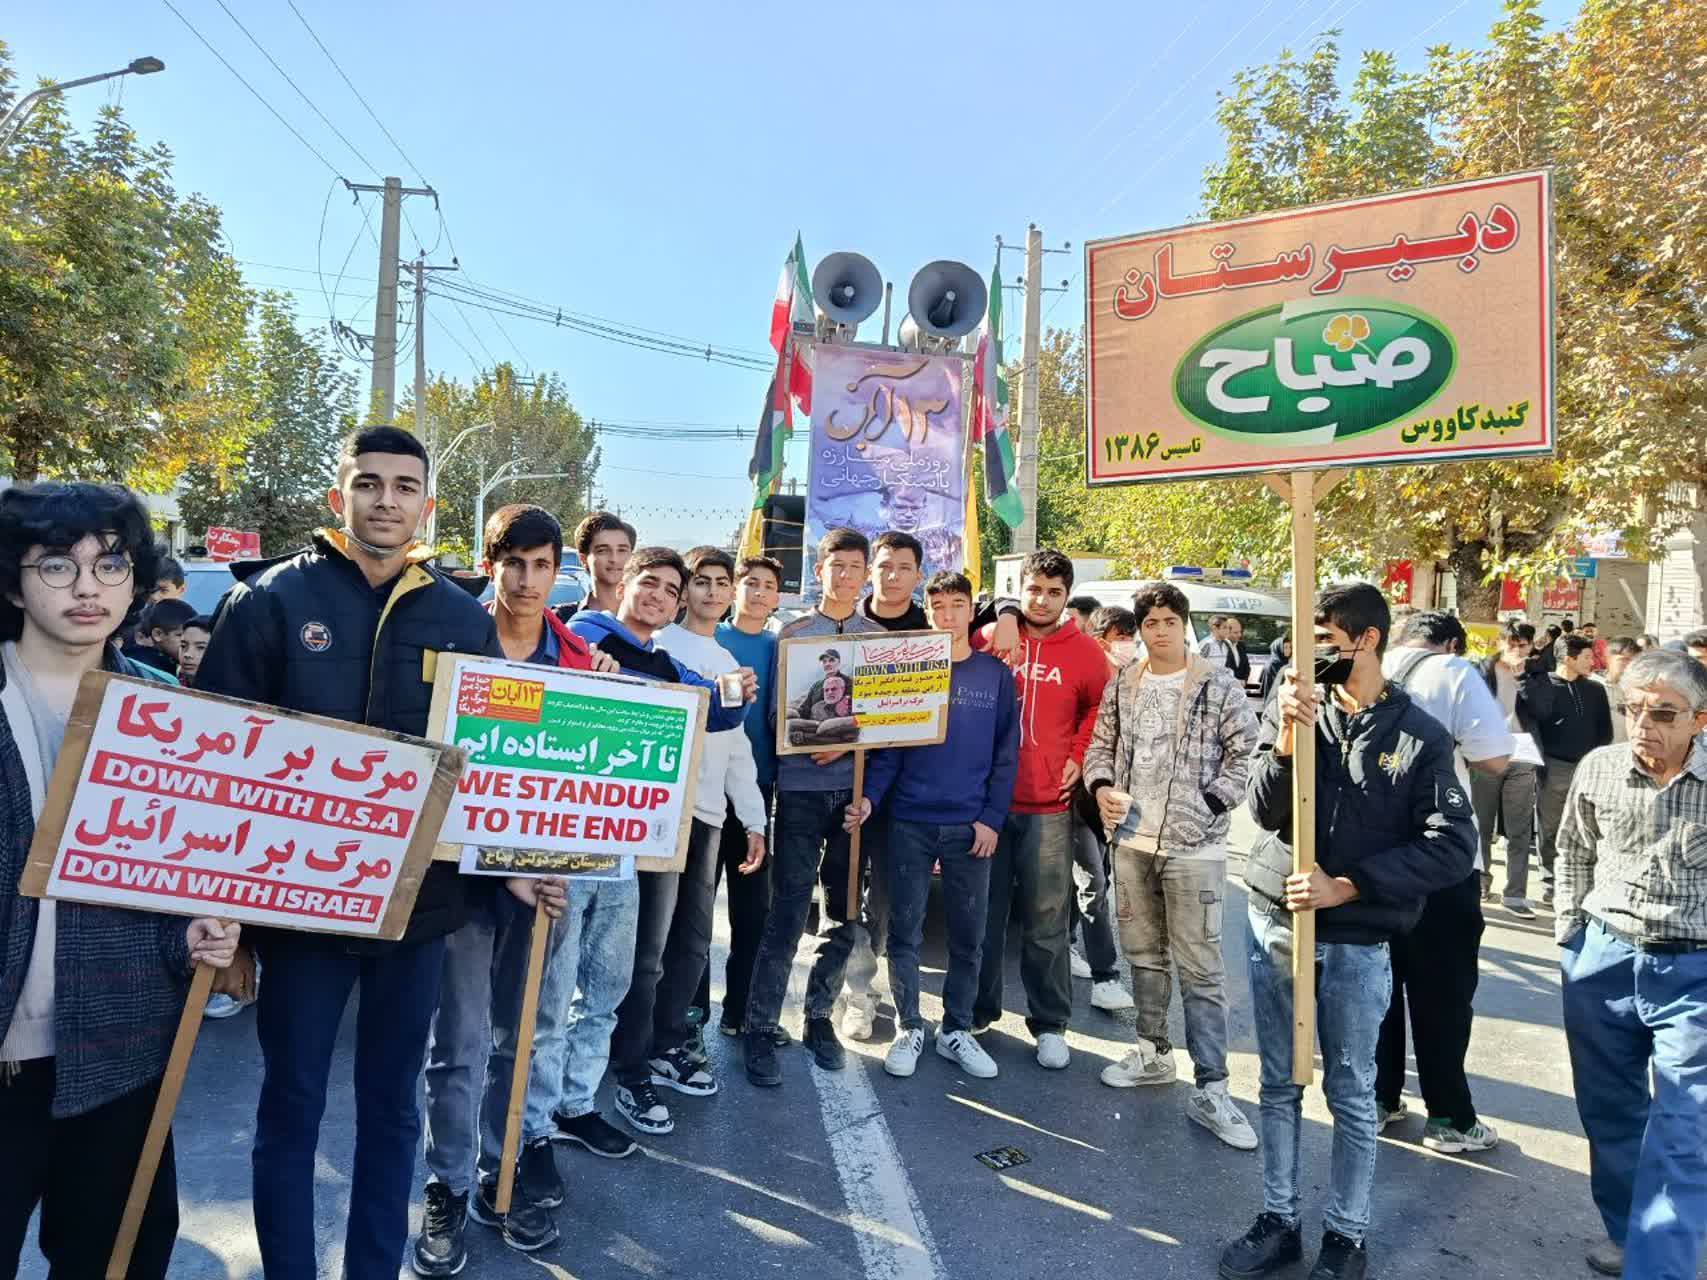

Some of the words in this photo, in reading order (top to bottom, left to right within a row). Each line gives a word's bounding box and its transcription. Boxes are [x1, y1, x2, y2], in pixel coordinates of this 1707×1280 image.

[1113, 203, 1519, 320] دبیرستان
[1199, 336, 1432, 412] صباح
[1401, 404, 1480, 443] کاووس
[1481, 400, 1529, 435] گنبد
[822, 445, 891, 469] مبارزه
[891, 451, 925, 472] ملی
[924, 456, 950, 472] روز
[1105, 432, 1160, 462] ۱۳۸۶
[1161, 437, 1201, 460] تاسیس
[821, 466, 878, 489] جهانی
[874, 471, 940, 489] استکبار
[940, 469, 950, 492] با
[462, 674, 491, 684] حماسه
[856, 663, 889, 676] DOWN
[895, 660, 922, 673] WITH
[928, 659, 949, 671] USA
[461, 683, 491, 693] مردمی
[470, 692, 489, 705] مرگ
[491, 683, 521, 705] آبان
[523, 685, 542, 705] ۱۳
[117, 694, 276, 763] آمریکا
[264, 745, 315, 782] بر
[502, 731, 598, 771] ایستاده
[598, 740, 657, 775] آخر
[657, 744, 678, 773] تا
[331, 750, 417, 798] مرگ
[458, 770, 513, 798] WE
[516, 775, 670, 810] STANDUP
[104, 759, 220, 799] DOWN
[229, 776, 315, 817] WITH
[321, 806, 400, 832] U.S.A
[73, 795, 252, 861] اسرائیل
[463, 805, 510, 833] TO
[516, 809, 580, 840] THE
[583, 815, 648, 843] END
[246, 838, 297, 877] بر
[304, 840, 392, 888] مرگ
[64, 855, 182, 893] DOWN
[185, 871, 271, 905] WITH
[277, 888, 377, 919] ISRAEL
